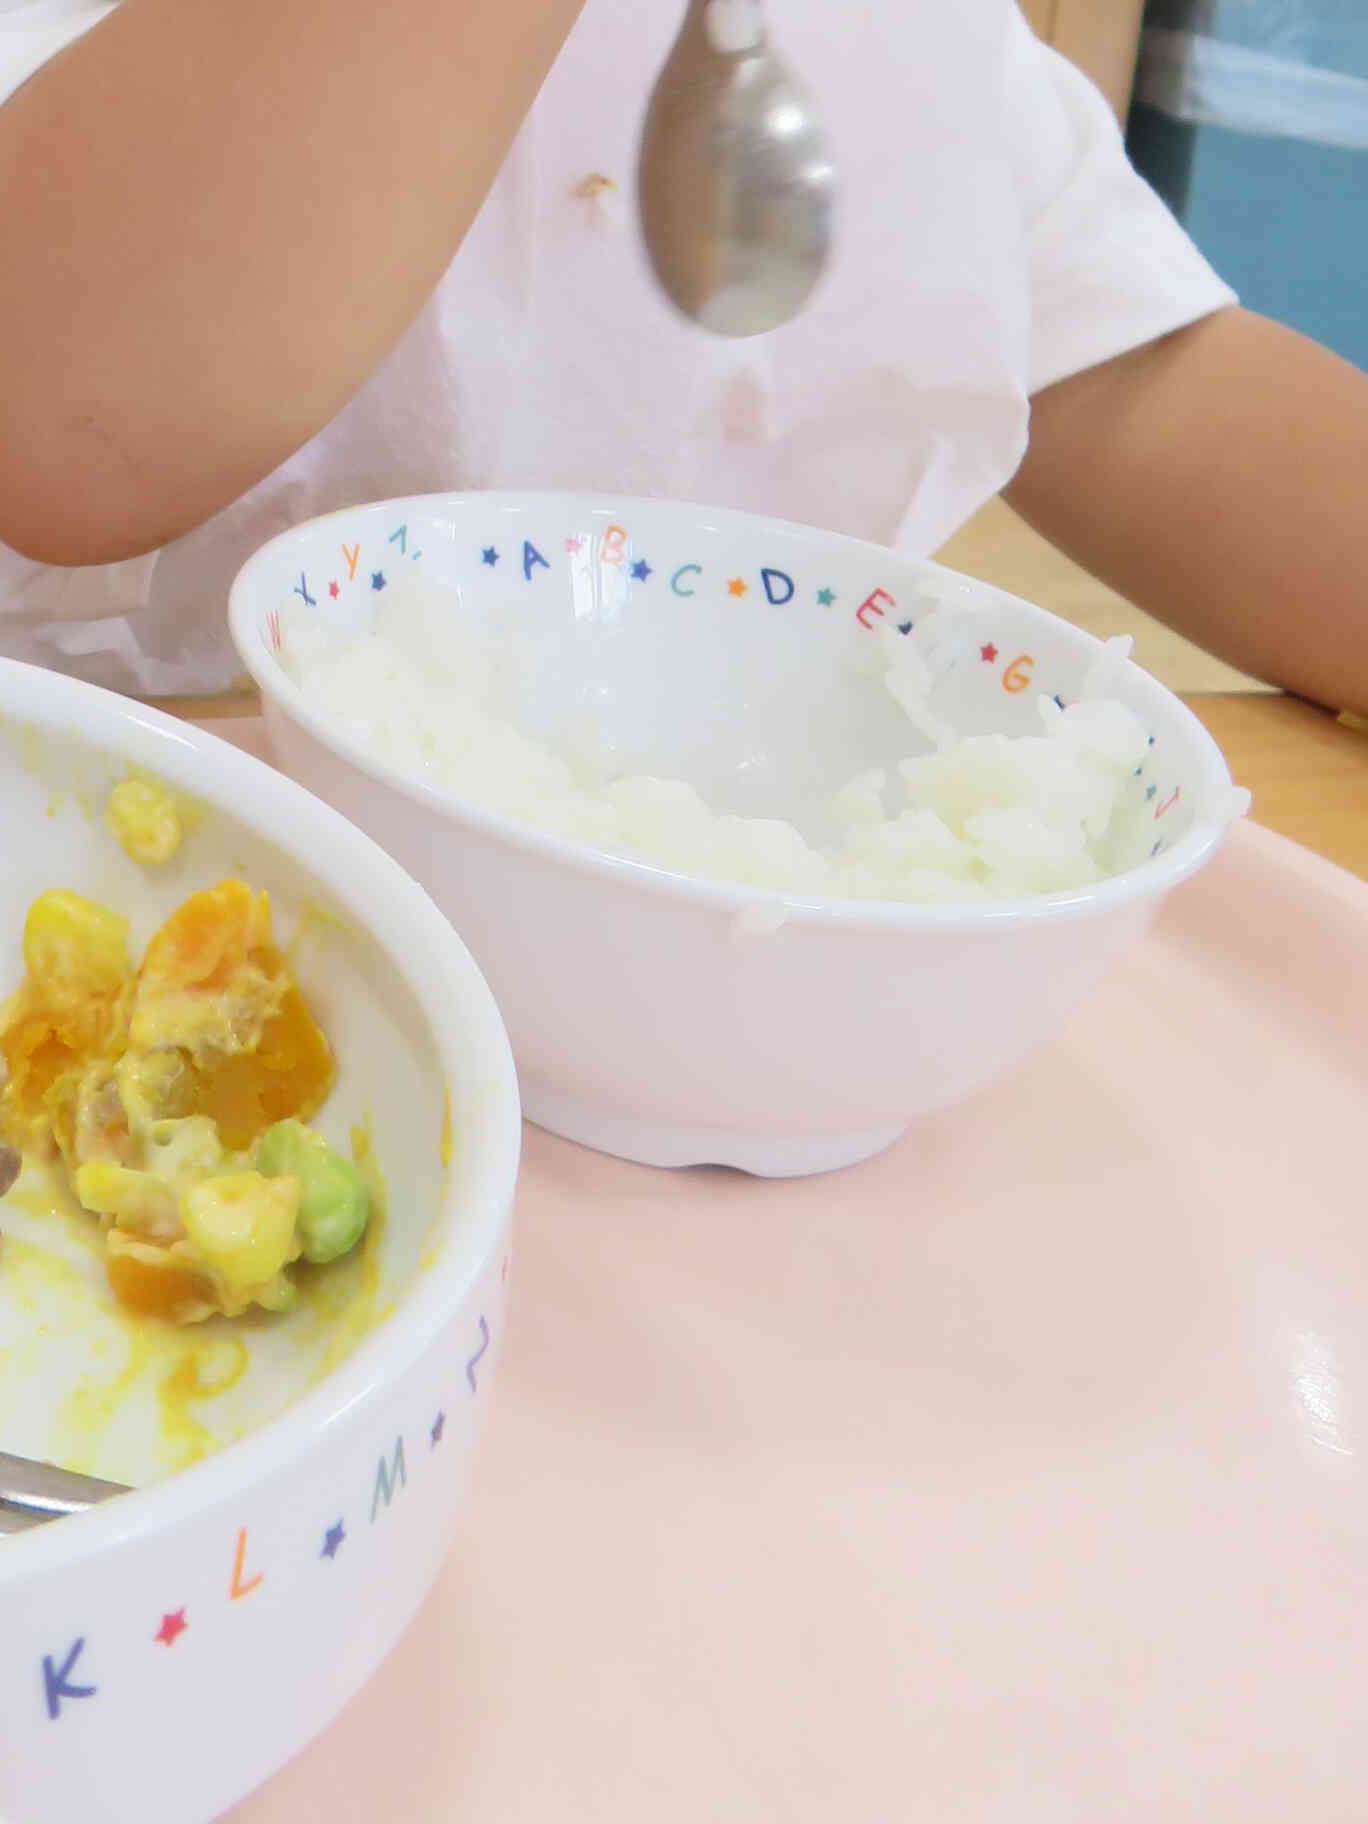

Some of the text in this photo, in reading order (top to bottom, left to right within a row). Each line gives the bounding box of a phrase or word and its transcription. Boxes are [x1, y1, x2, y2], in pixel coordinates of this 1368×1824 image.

[341, 542, 361, 581] Y
[522, 540, 550, 581] A
[599, 524, 627, 565] B
[669, 563, 703, 598] C
[759, 567, 796, 606] D
[855, 586, 897, 630] E
[1001, 654, 1035, 694] G
[42, 1636, 97, 1721] K
[230, 1527, 264, 1601] L
[370, 1434, 408, 1525] M
